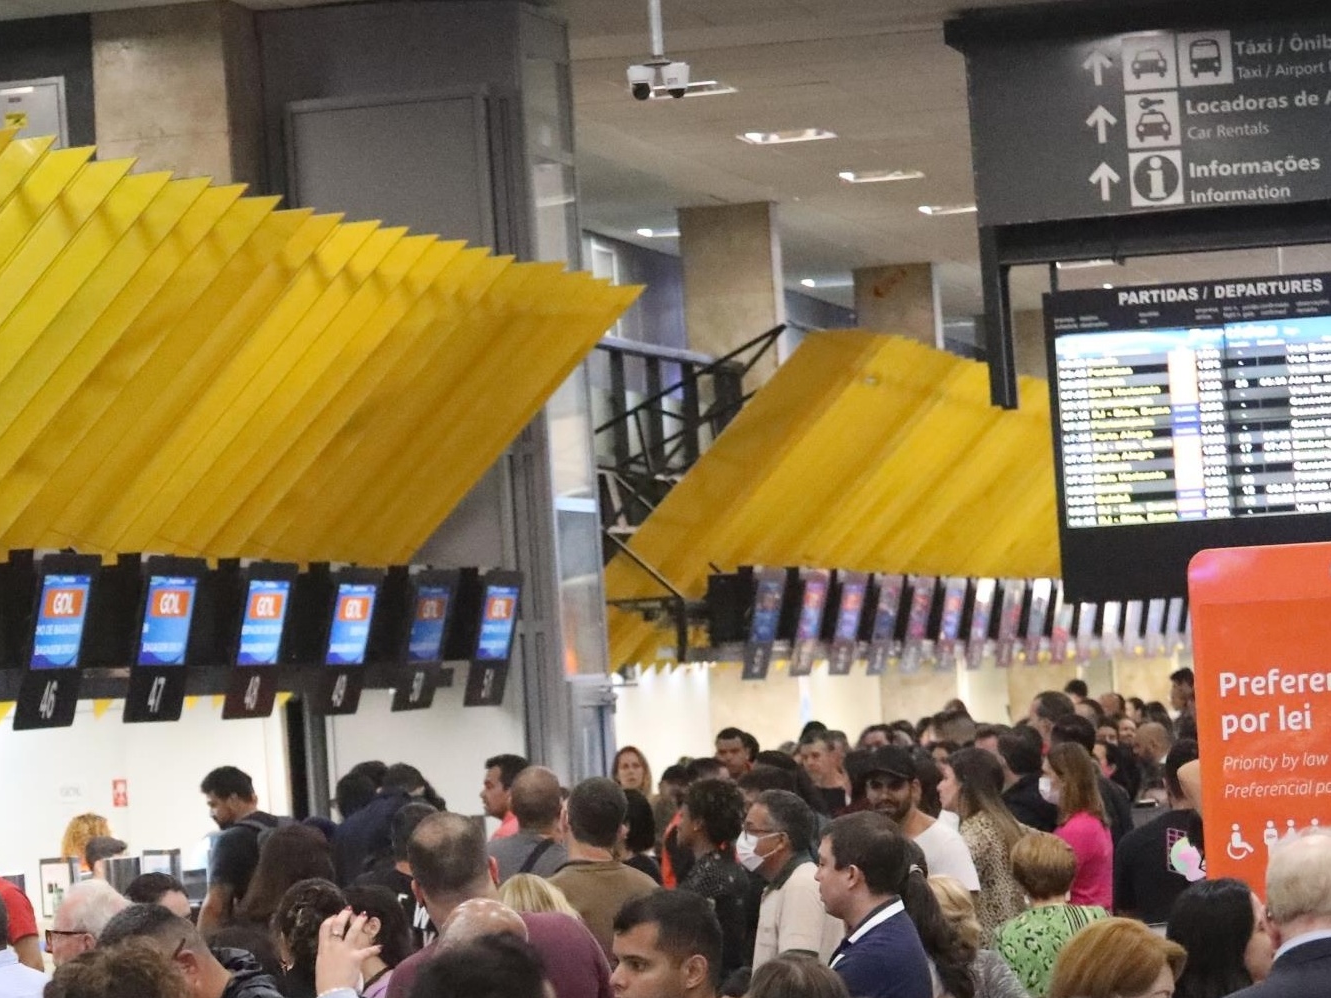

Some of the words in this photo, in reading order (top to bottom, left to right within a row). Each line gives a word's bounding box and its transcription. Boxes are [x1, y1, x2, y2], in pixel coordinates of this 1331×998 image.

[1234, 38, 1272, 55] Táxi
[1277, 38, 1285, 54] /
[1236, 64, 1262, 79] Taxi
[1274, 62, 1325, 78] Airport
[1185, 94, 1289, 115] Locadoras
[1294, 89, 1320, 107] de
[1187, 126, 1212, 140] Car
[1217, 121, 1270, 138] Rentals
[1189, 155, 1321, 179] Informações
[1191, 184, 1291, 203] Information
[1118, 287, 1199, 306] PARTIDAS
[1214, 278, 1323, 299] DEPARTURES
[53, 593, 74, 615] GOL
[160, 593, 180, 615] GOL
[257, 596, 275, 616] GOL
[345, 599, 362, 618] GOL
[39, 680, 58, 719] 46
[147, 676, 166, 713] 47
[1221, 713, 1270, 741] por
[1278, 703, 1312, 731] lei
[1223, 754, 1278, 774] Priority
[1281, 752, 1300, 771] by
[1302, 751, 1329, 767] law
[1224, 780, 1313, 799] Preferencial
